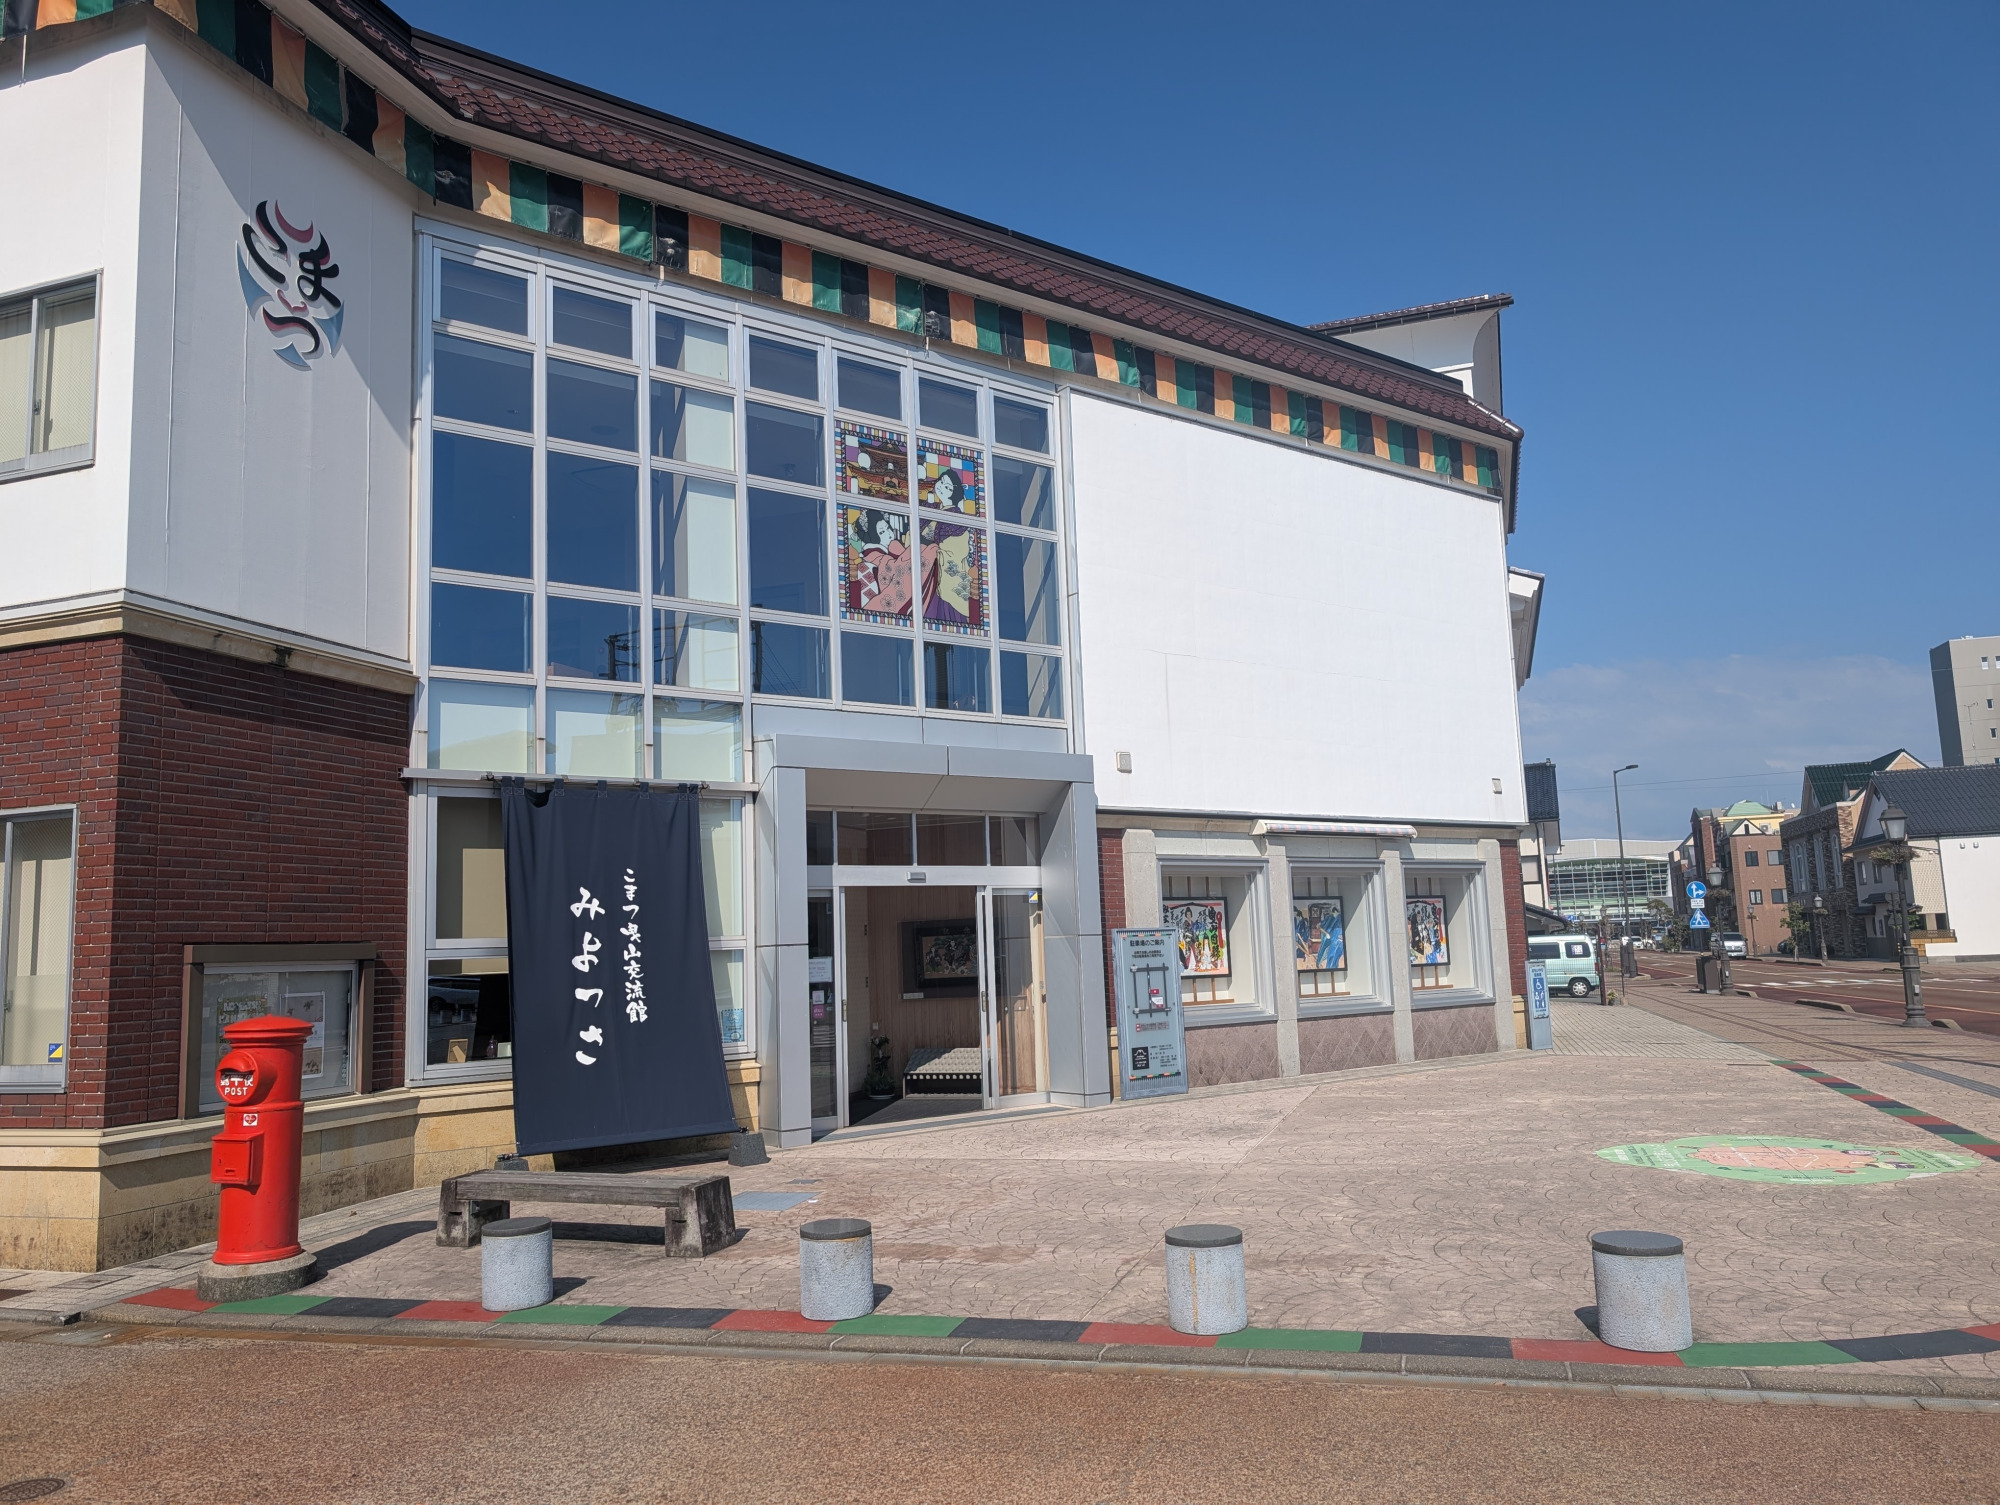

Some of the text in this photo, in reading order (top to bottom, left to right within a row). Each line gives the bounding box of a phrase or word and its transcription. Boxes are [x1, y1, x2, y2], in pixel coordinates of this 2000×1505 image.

[620, 868, 648, 1023] こまつ曳山交流館
[224, 1087, 248, 1096] POST
